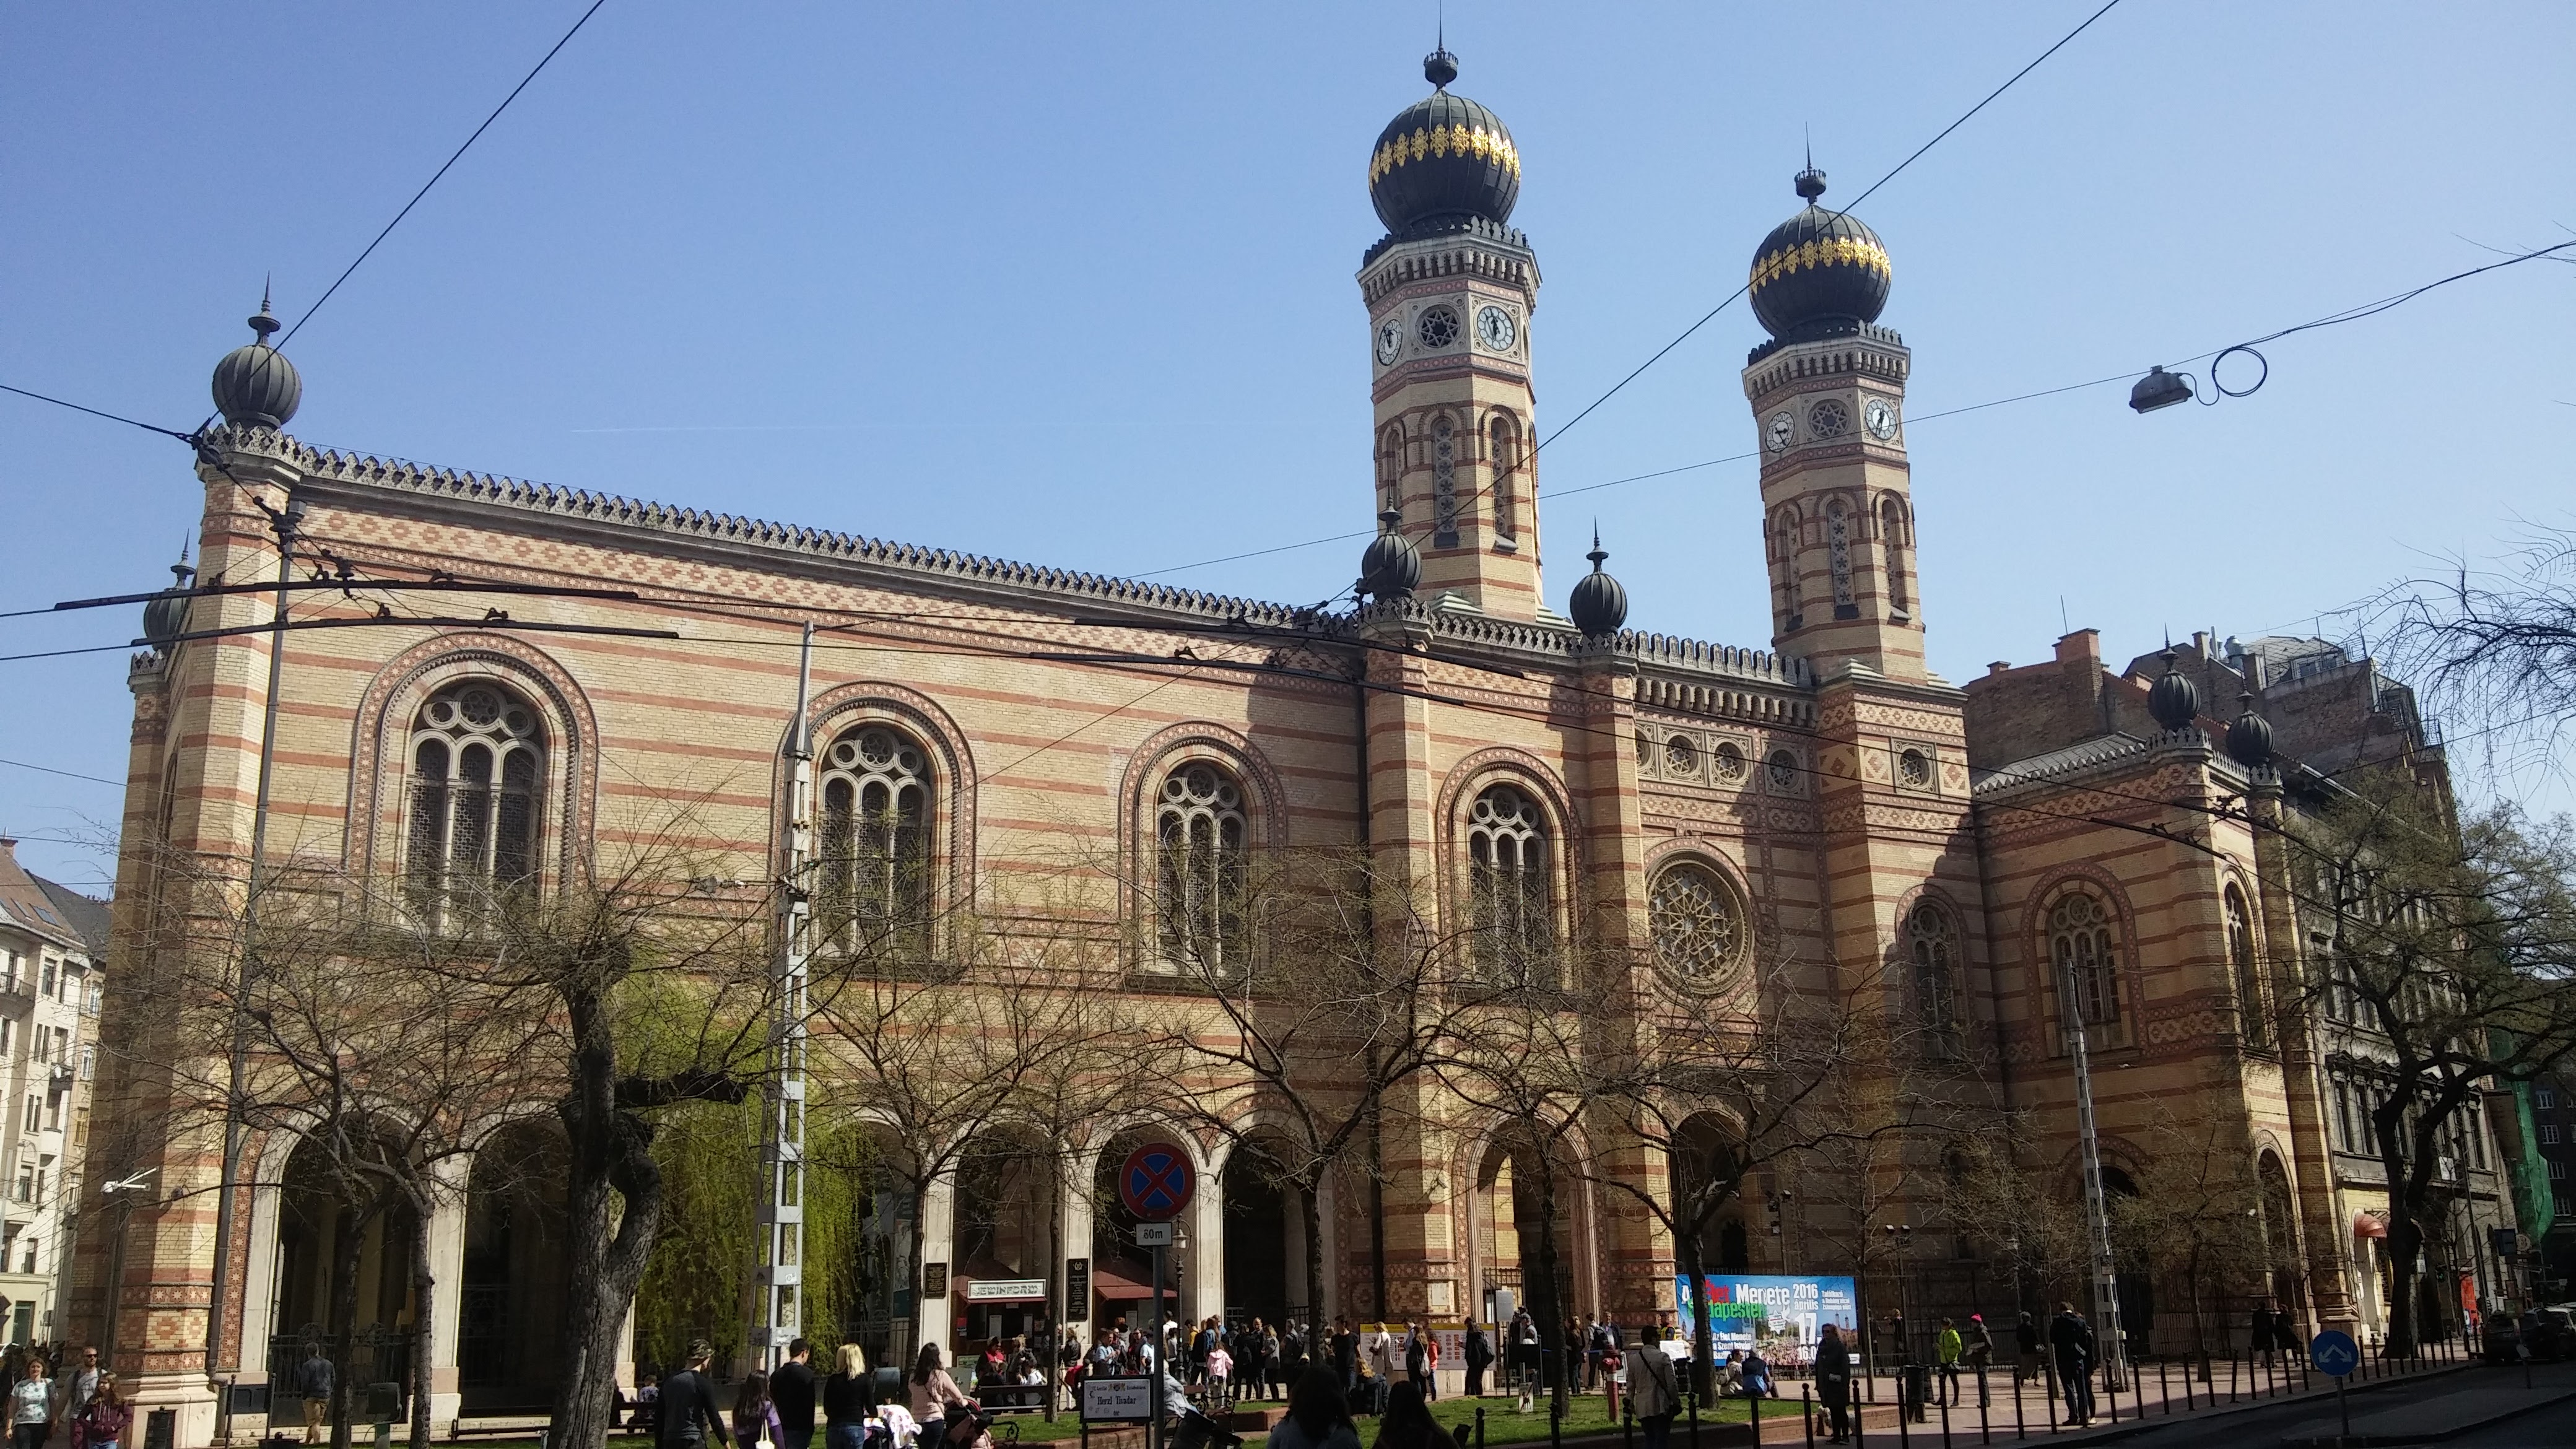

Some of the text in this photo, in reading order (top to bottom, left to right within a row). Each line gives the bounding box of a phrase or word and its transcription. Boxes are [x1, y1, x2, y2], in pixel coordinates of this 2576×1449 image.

[972, 1285, 1038, 1297] JEWINFORM
[1681, 1284, 1692, 1304] A
[1735, 1283, 1790, 1306] Menete
[1793, 1283, 1819, 1299] 2016
[1687, 1297, 1768, 1322] Bdapesten
[1795, 1299, 1819, 1310] április
[1797, 1346, 1818, 1360] 16.0
[1097, 1395, 1137, 1405] Herzl Tivadar
